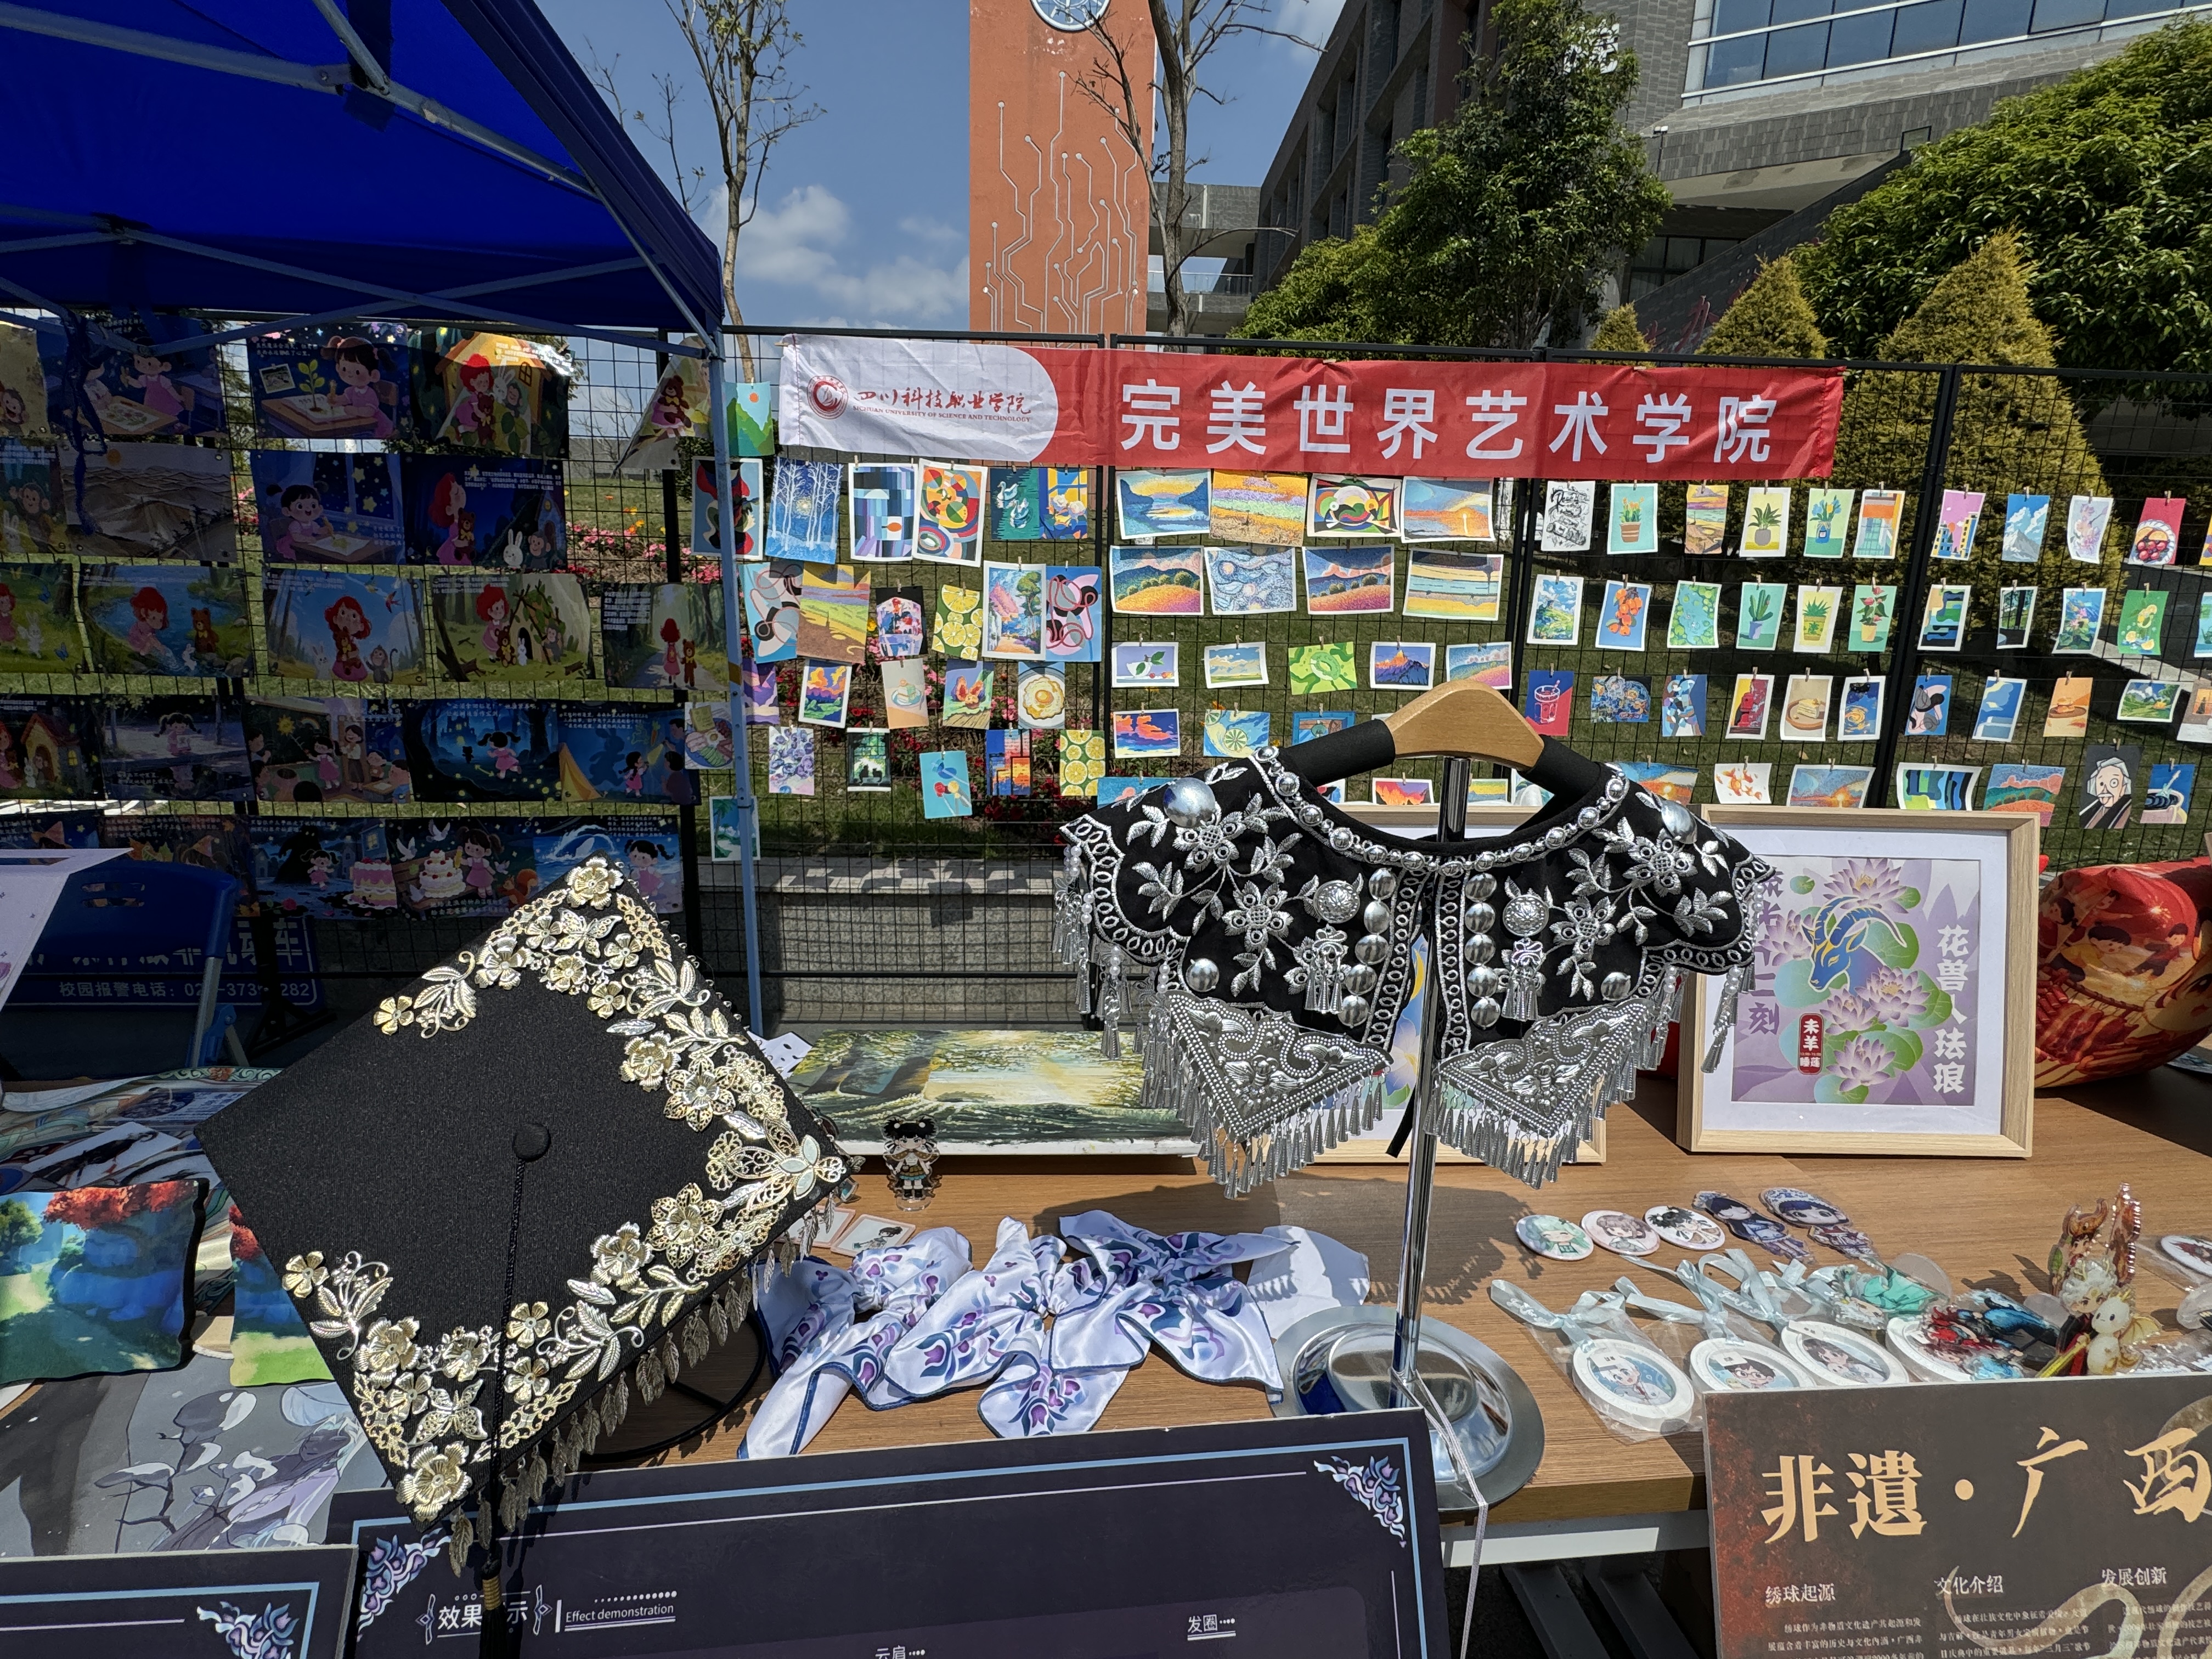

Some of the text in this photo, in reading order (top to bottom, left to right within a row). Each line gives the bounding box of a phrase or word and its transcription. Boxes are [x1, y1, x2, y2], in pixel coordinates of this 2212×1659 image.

[853, 386, 1031, 415] 四川科技职业学院
[853, 405, 884, 413] SICHUAN
[885, 409, 927, 417] UNIVERSITY
[984, 414, 1031, 422] TECHNOLOGY
[1120, 377, 1778, 465] 完美世界艺术学院
[1802, 1018, 1820, 1051] 未羊
[1933, 1574, 2004, 1595] 文化介绍
[2101, 1566, 2168, 1586] 发展创新
[1764, 1582, 1836, 1605] 绣球起源
[438, 1600, 528, 1630] 效果示
[566, 1603, 674, 1623] Effect demonstration
